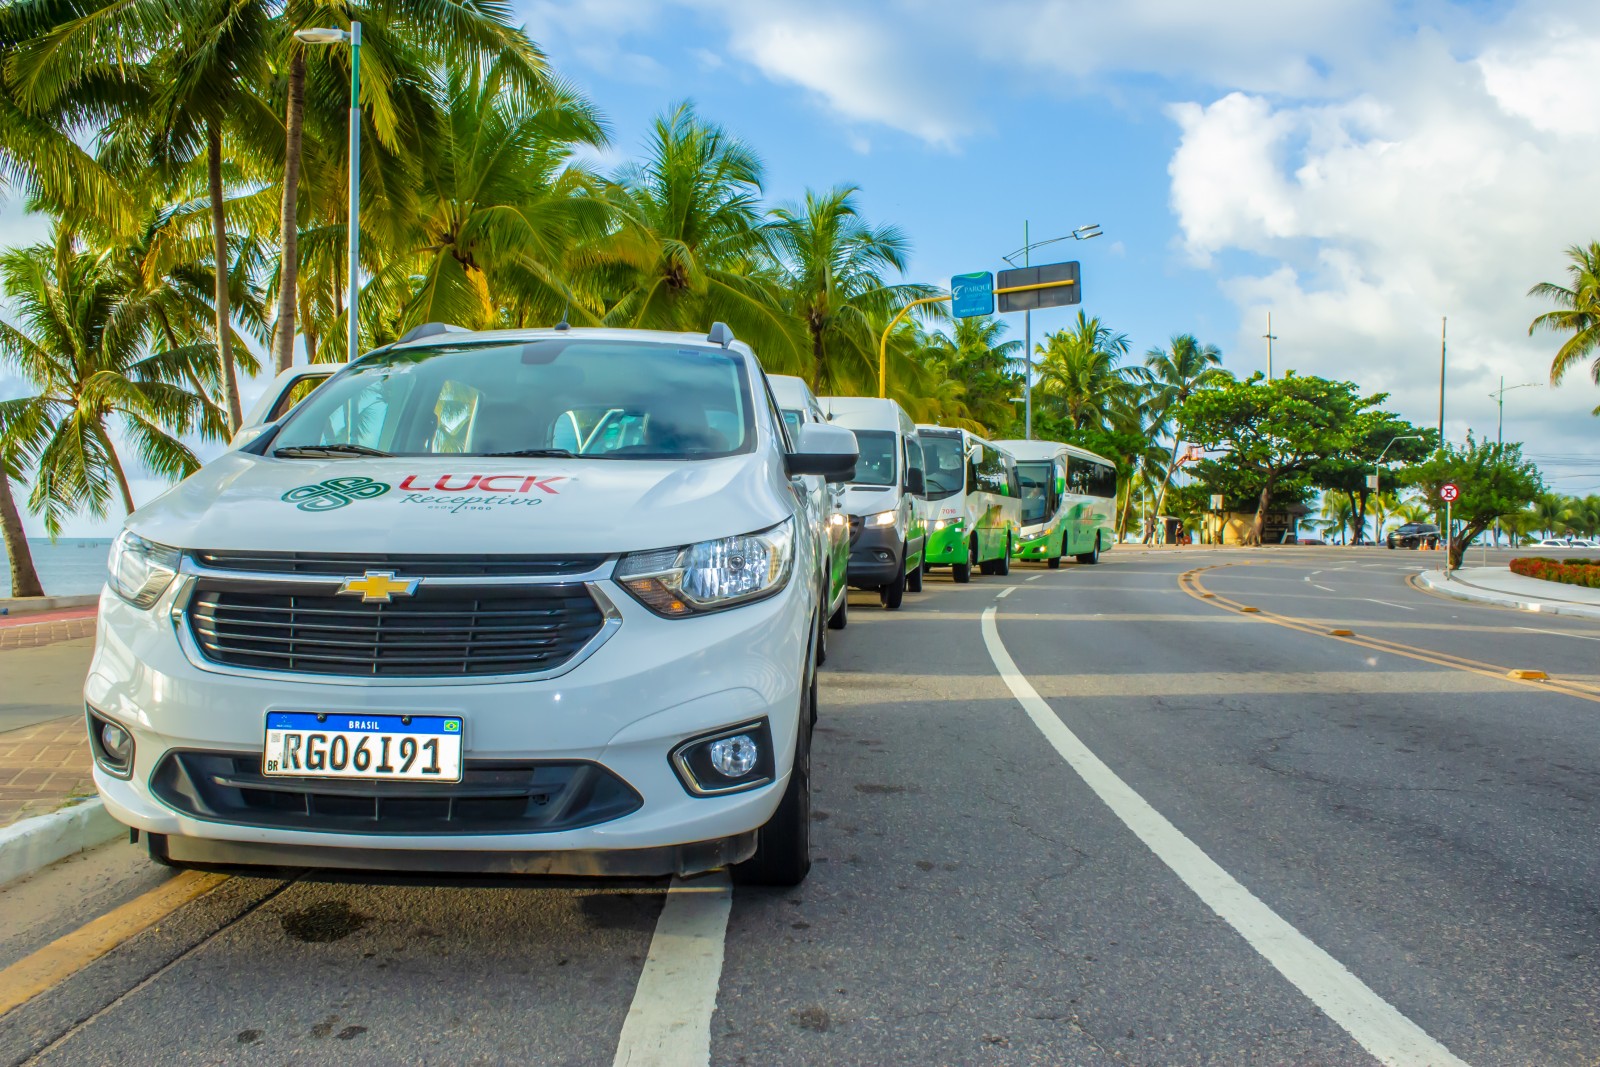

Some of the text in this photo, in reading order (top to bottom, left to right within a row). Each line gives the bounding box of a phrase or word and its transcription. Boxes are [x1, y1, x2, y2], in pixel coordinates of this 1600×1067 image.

[399, 475, 567, 494] LUCK
[399, 493, 543, 513] Receptivo
[348, 720, 380, 730] BRASIL
[267, 760, 279, 771] BR
